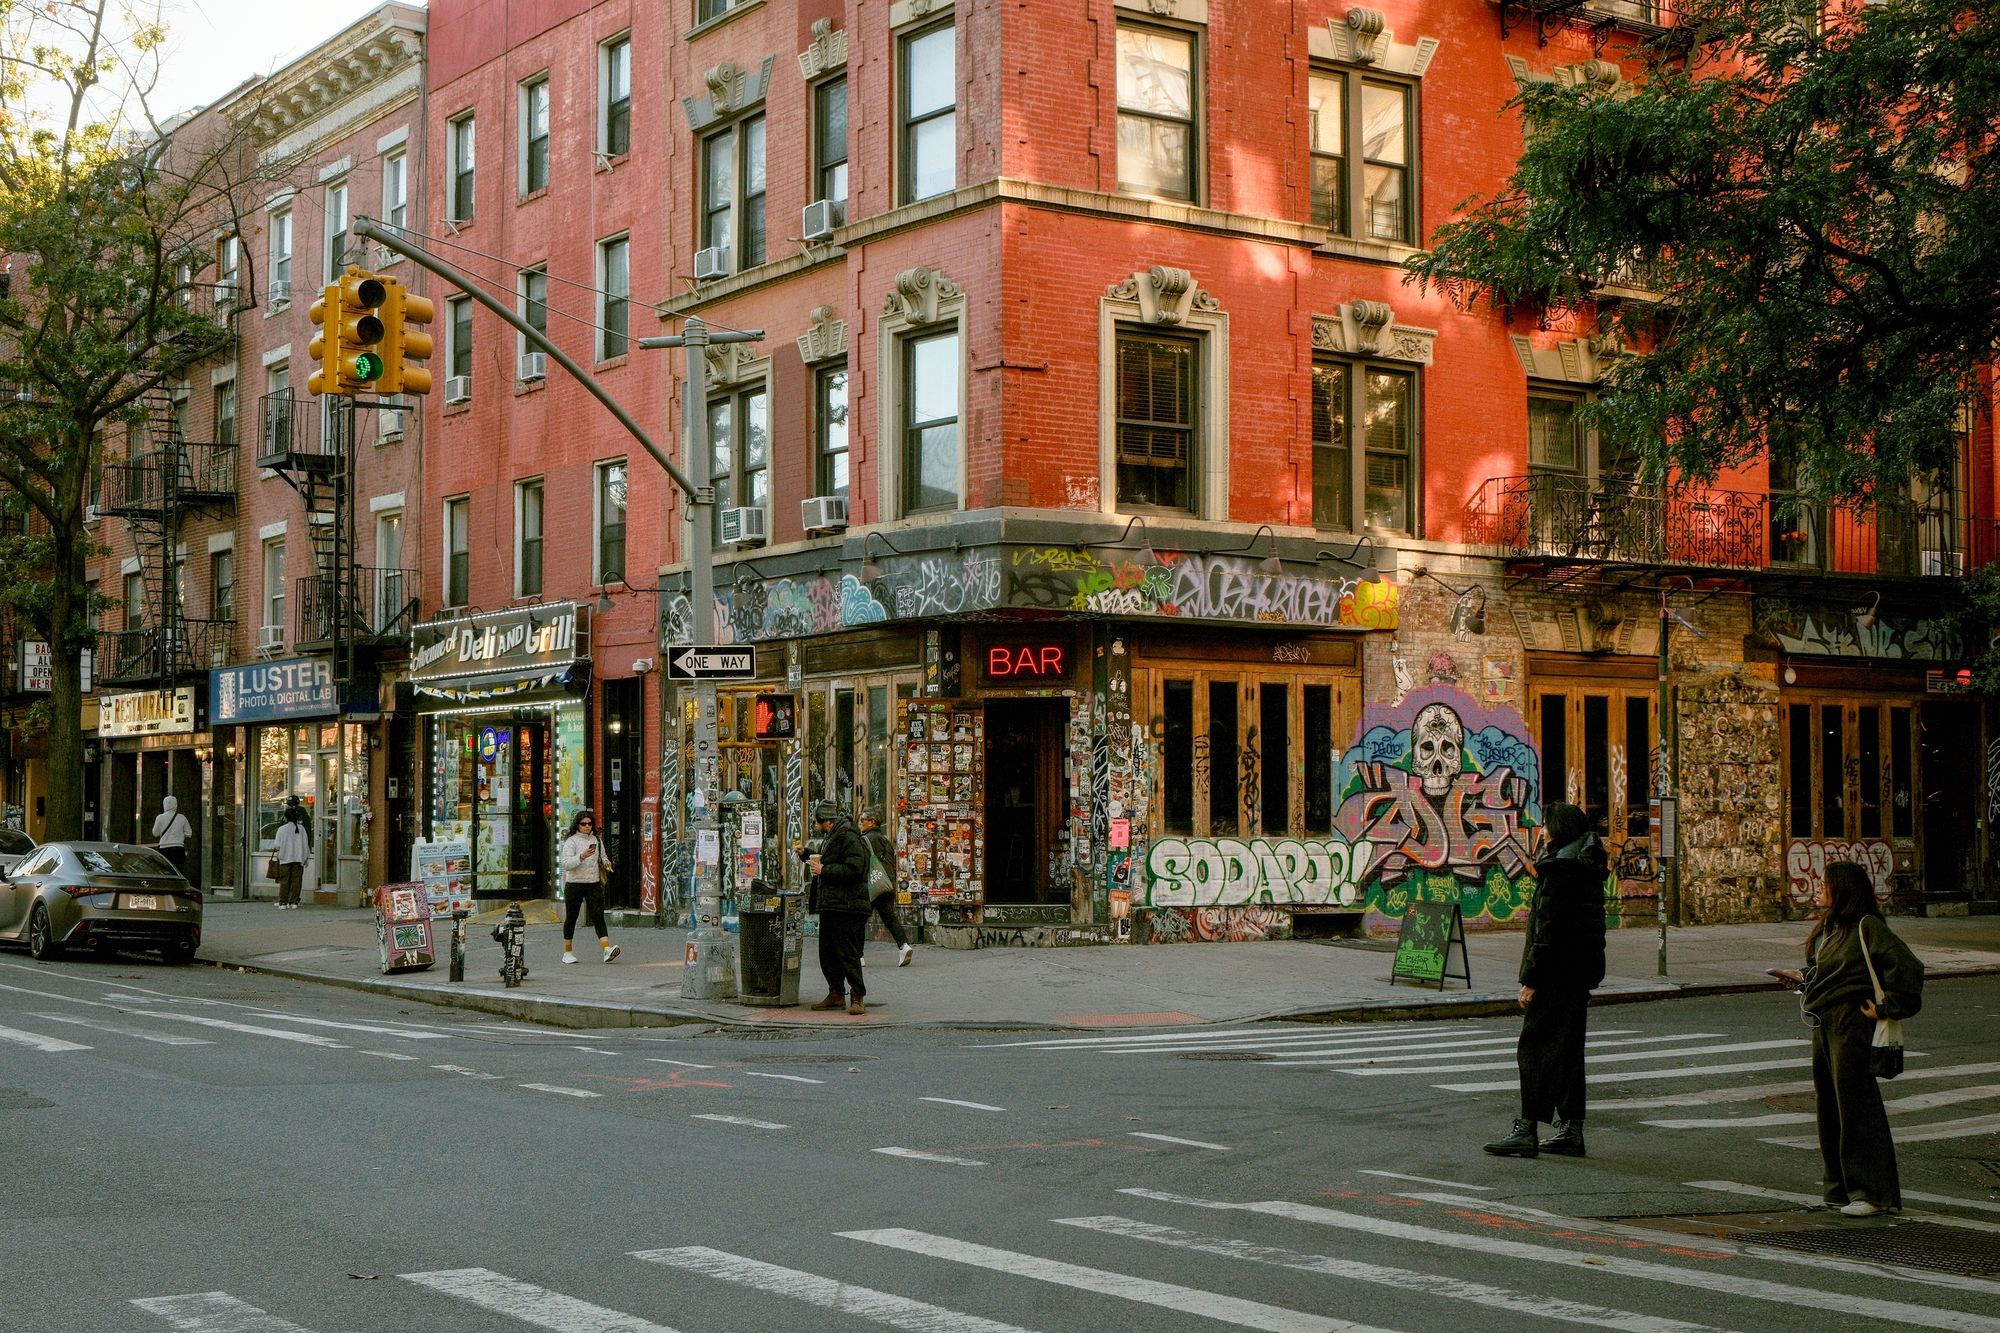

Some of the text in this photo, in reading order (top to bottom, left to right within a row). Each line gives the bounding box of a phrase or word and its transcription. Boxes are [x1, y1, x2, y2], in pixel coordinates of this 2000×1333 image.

[458, 625, 498, 662] Deli
[497, 624, 525, 657] AND
[525, 614, 573, 654] Grill
[685, 655, 746, 669] ONE WAY
[990, 647, 1062, 675] BAR
[239, 661, 331, 694] LUSTER
[239, 687, 332, 709] PHOTO & DIGITAL LAB
